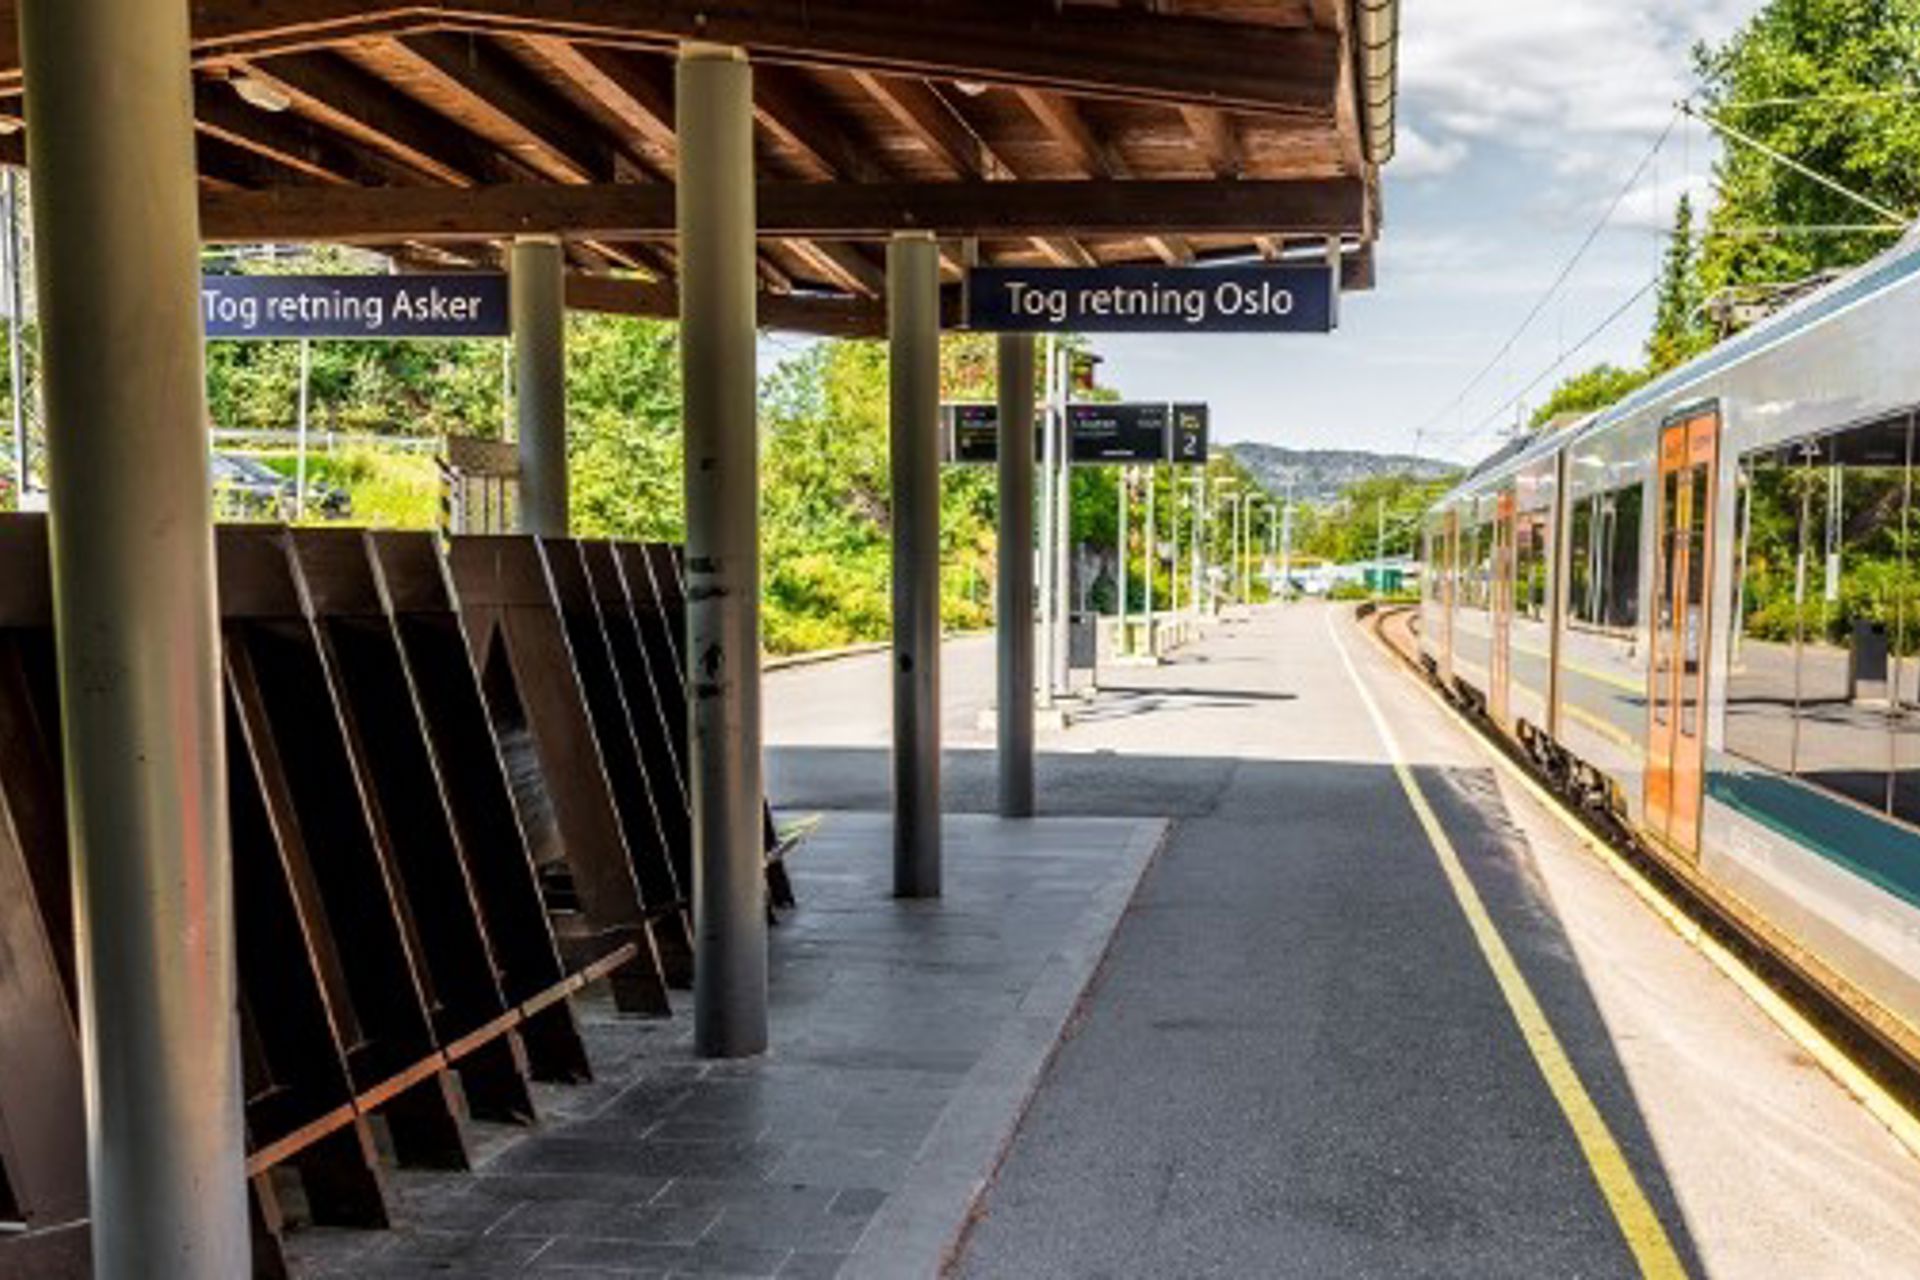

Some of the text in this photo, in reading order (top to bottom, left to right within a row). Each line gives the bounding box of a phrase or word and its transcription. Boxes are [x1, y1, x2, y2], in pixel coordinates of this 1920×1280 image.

[202, 288, 481, 329] Tog retning Asker
[1005, 282, 1293, 322] Tog retning Oslo
[1184, 434, 1197, 455] 2
